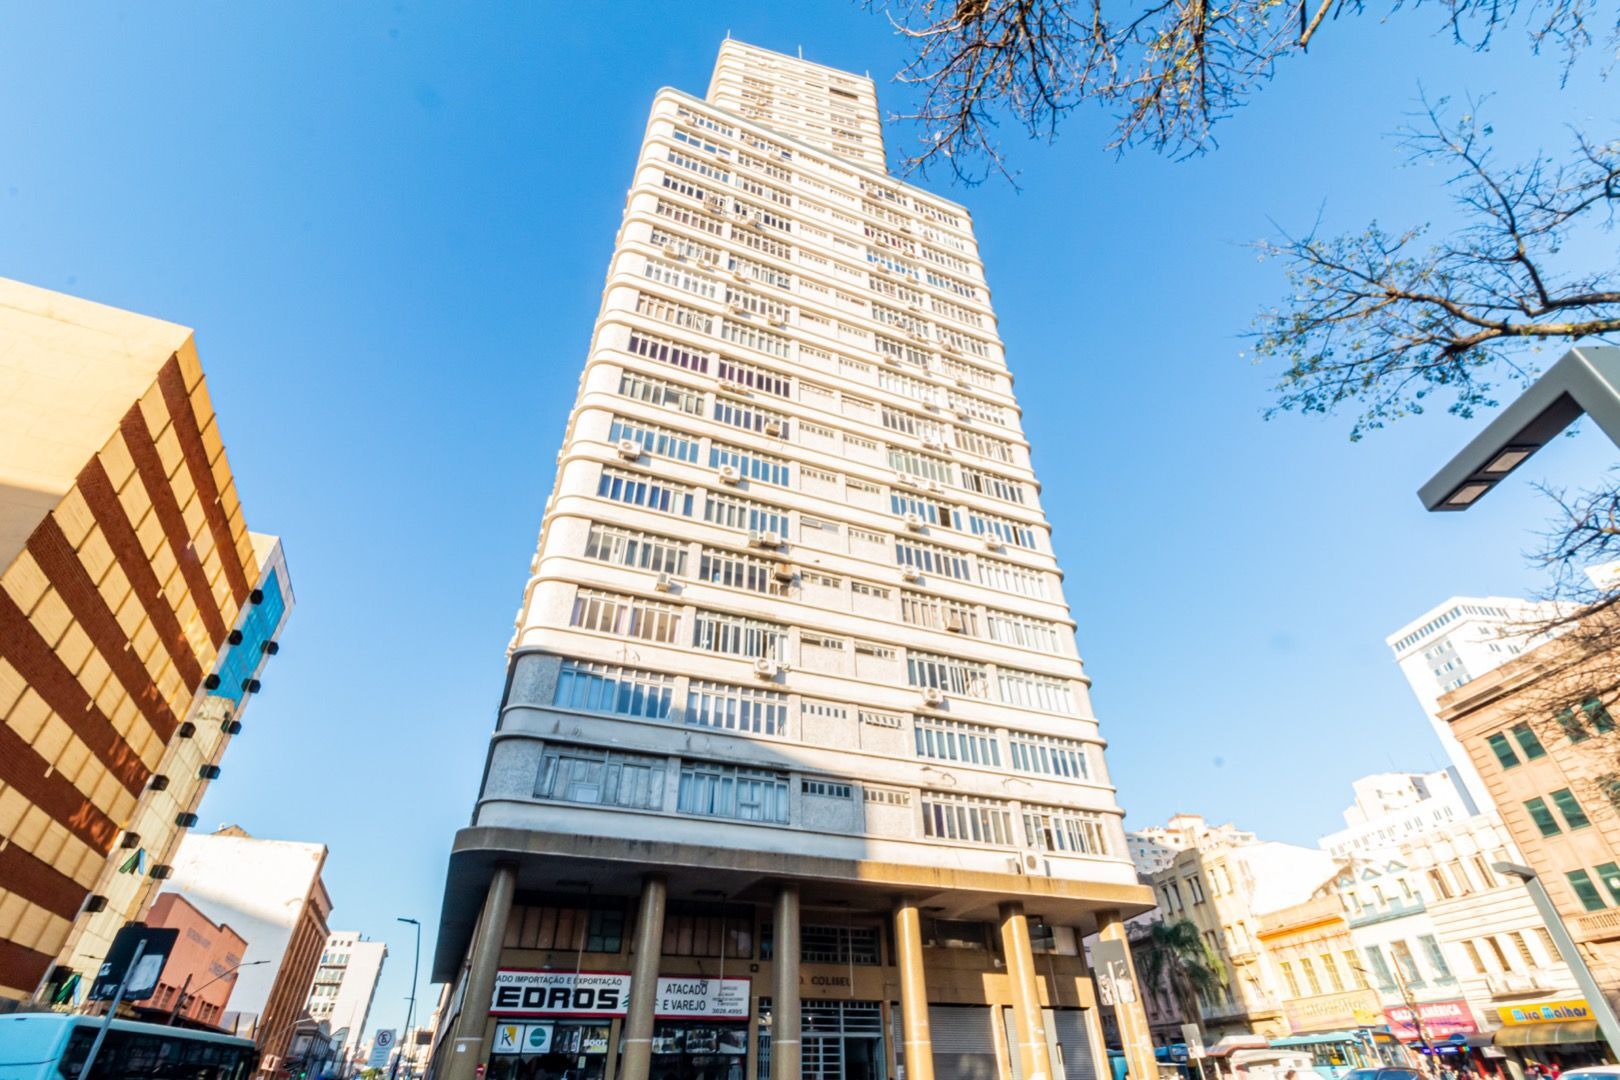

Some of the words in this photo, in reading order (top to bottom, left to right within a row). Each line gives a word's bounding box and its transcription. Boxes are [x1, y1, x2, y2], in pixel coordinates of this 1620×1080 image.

[515, 975, 564, 985] IMPORTAÇÃO
[573, 976, 623, 986] EXPORTAÇÃO
[666, 983, 708, 995] ATACADO
[490, 986, 620, 1010] EDROS
[663, 999, 669, 1011] E
[671, 1000, 706, 1011] VAREJO
[1541, 1006, 1587, 1019] Malhas
